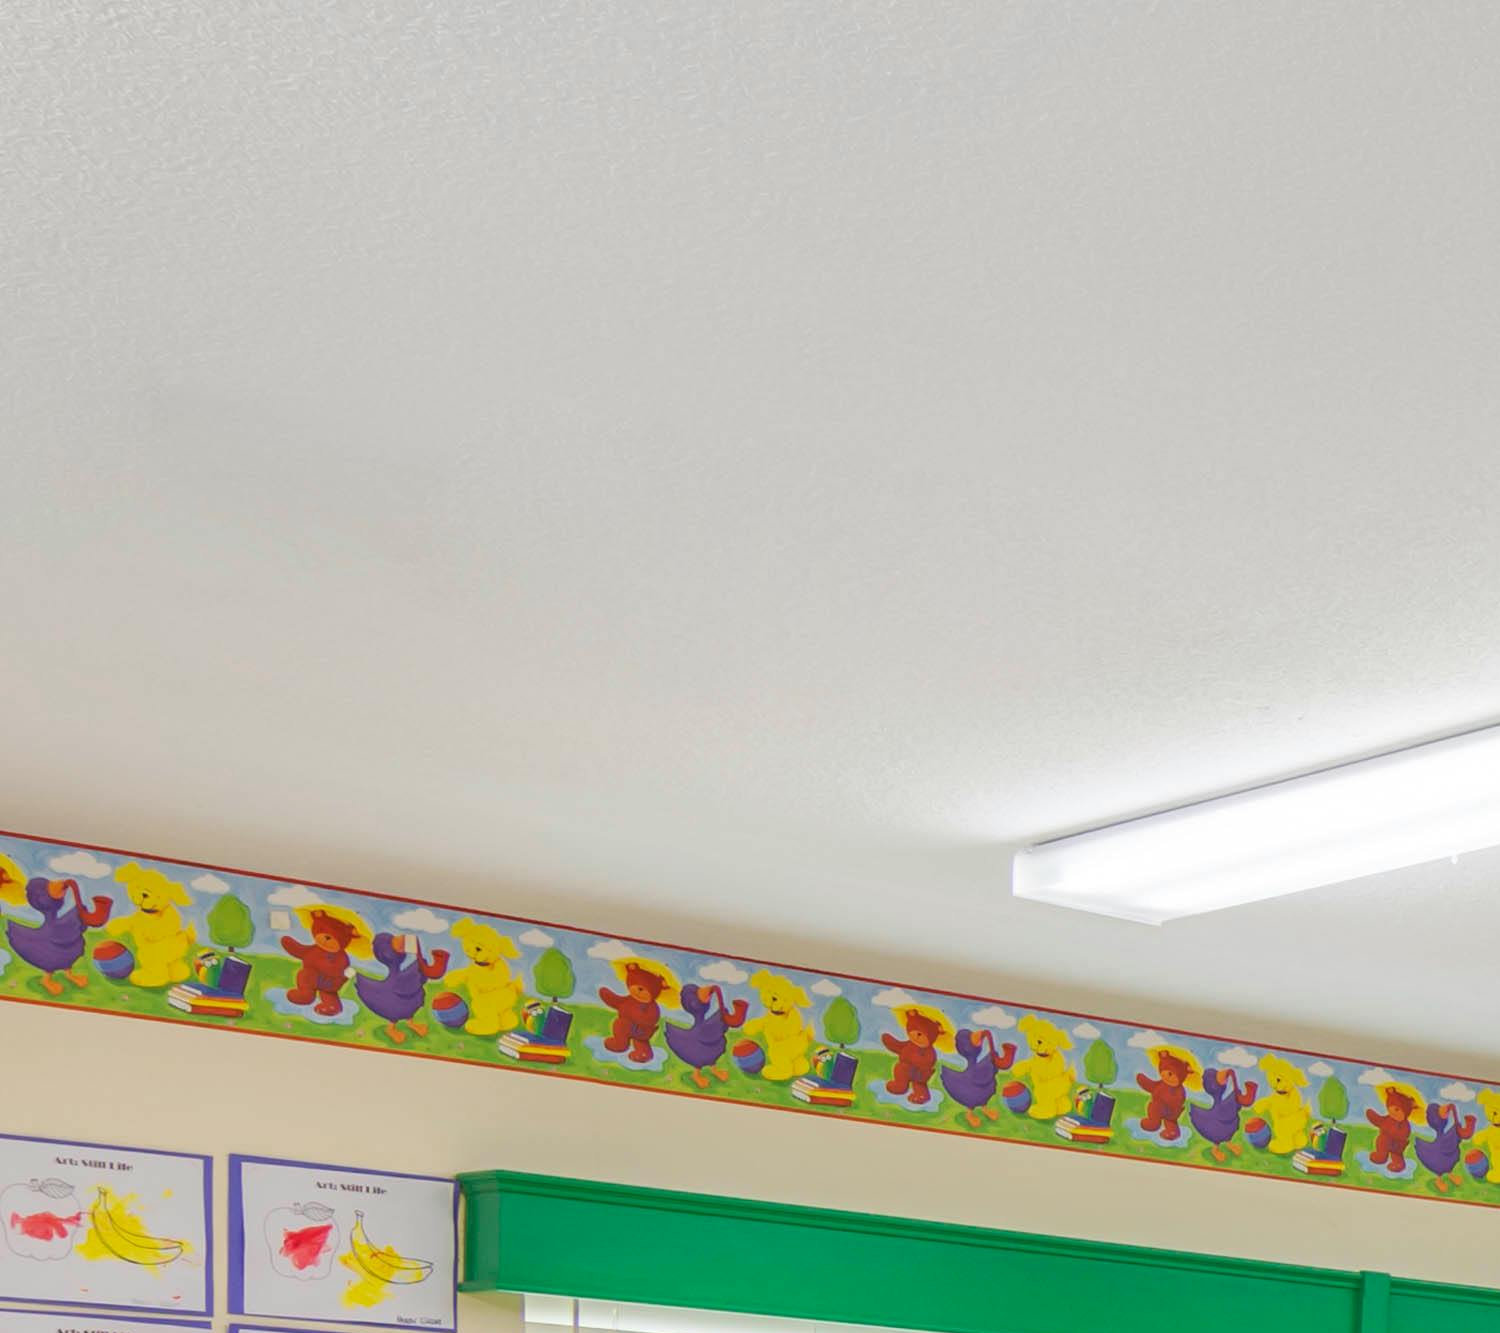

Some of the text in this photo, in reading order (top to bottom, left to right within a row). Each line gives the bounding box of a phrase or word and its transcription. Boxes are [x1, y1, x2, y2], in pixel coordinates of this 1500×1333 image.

[81, 1158, 107, 1171] Still
[109, 1161, 134, 1172] Life
[339, 1182, 364, 1194] Still
[366, 1185, 388, 1196] Life
